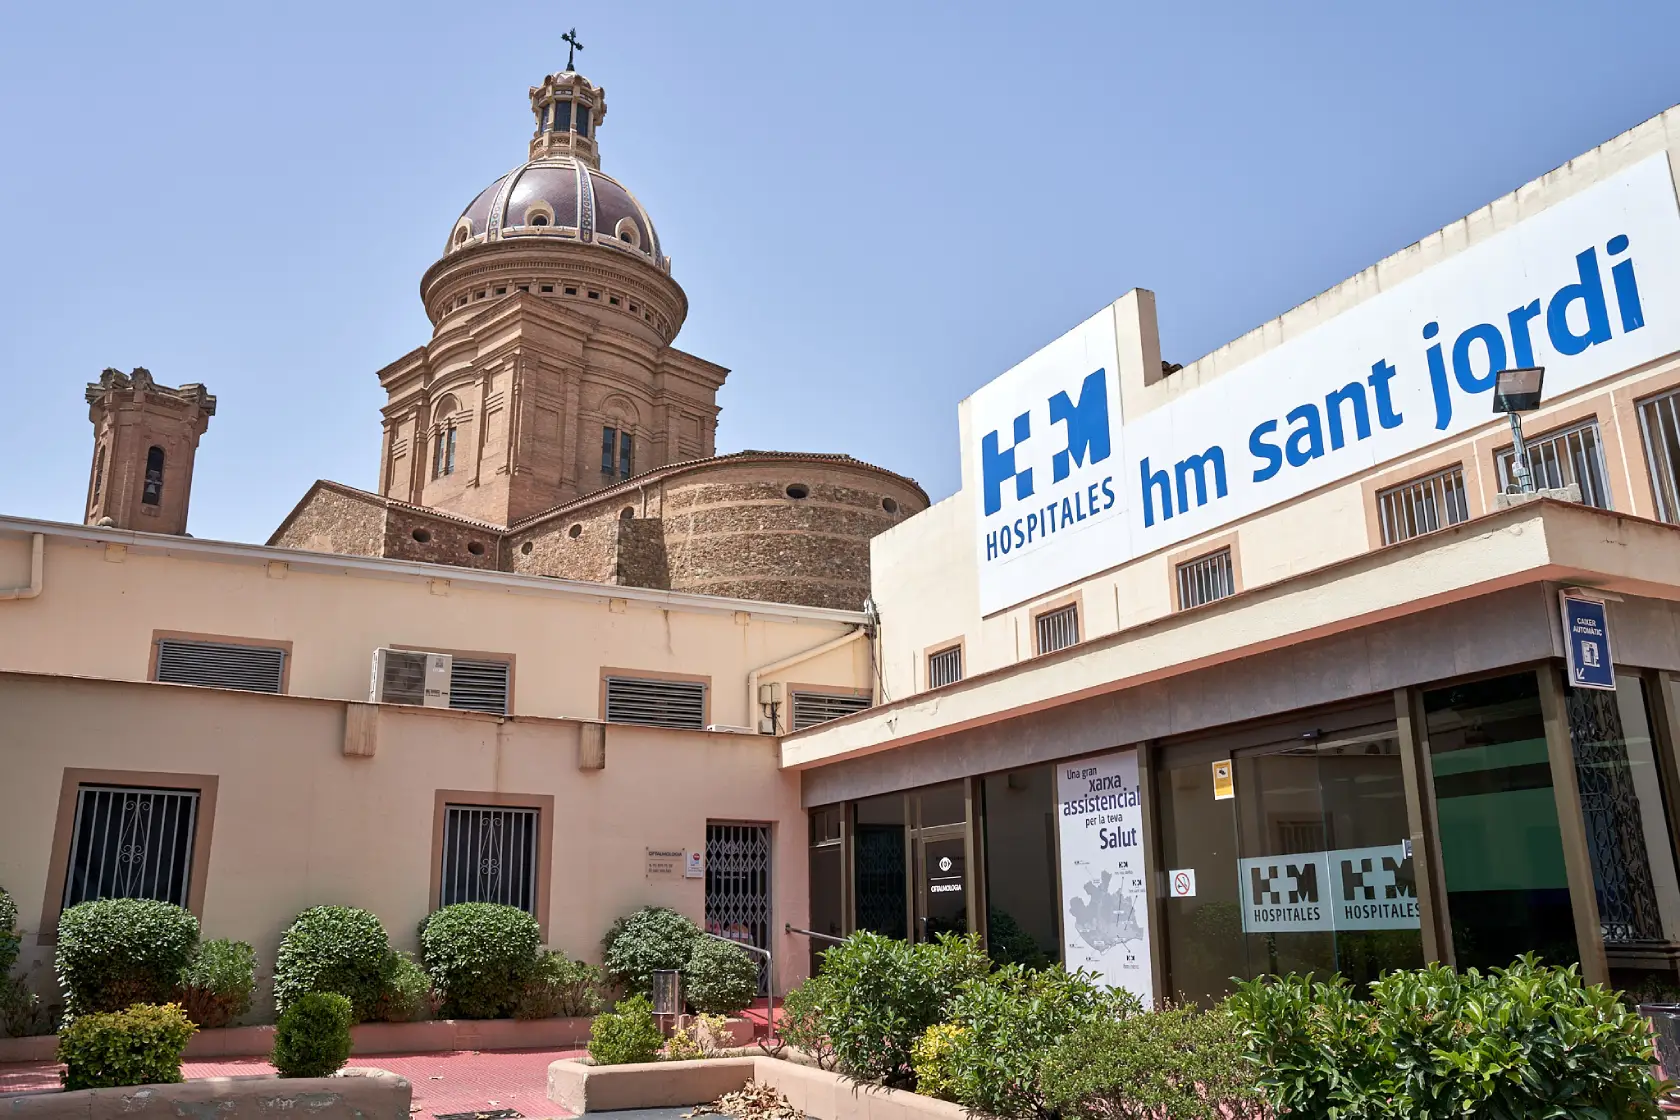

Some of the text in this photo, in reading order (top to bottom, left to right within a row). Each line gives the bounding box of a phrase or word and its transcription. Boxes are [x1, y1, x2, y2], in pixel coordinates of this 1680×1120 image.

[1139, 233, 1645, 528] hm sant jordi
[981, 367, 1112, 517] HM
[985, 476, 1115, 561] HOSPITALES
[1576, 617, 1596, 627] CAIXER
[1066, 766, 1097, 780] Una gran
[1088, 774, 1122, 793] xarxa
[1063, 785, 1141, 817] assistencial
[1085, 812, 1123, 828] per la teva
[1099, 826, 1138, 850] Salut
[1250, 863, 1319, 905] HM
[1254, 906, 1321, 923] HOSPITALES
